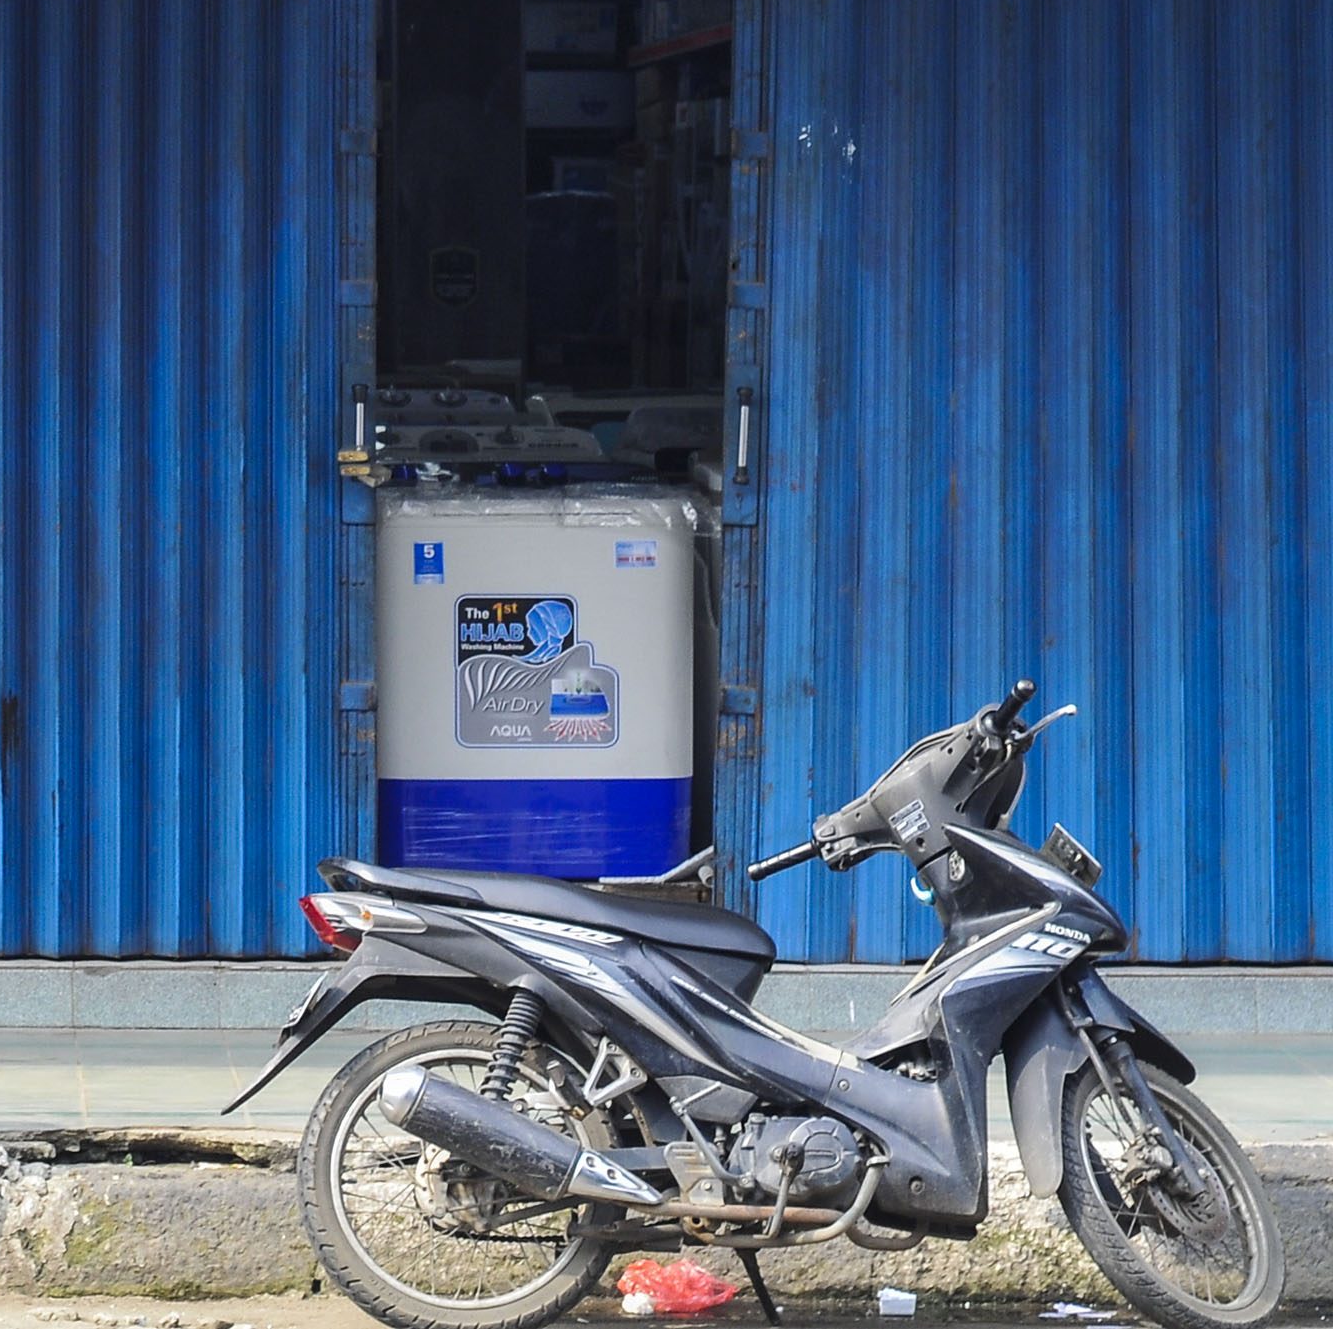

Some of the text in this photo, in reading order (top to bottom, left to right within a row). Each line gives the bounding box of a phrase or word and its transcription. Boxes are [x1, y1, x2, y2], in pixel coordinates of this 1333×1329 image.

[424, 544, 435, 559] 5
[465, 602, 518, 622] The 1st
[461, 623, 525, 642] HIJAB
[494, 643, 525, 651] Machine
[490, 725, 532, 737] AQUA
[1044, 922, 1091, 943] HONDA
[1011, 932, 1079, 959] 110
